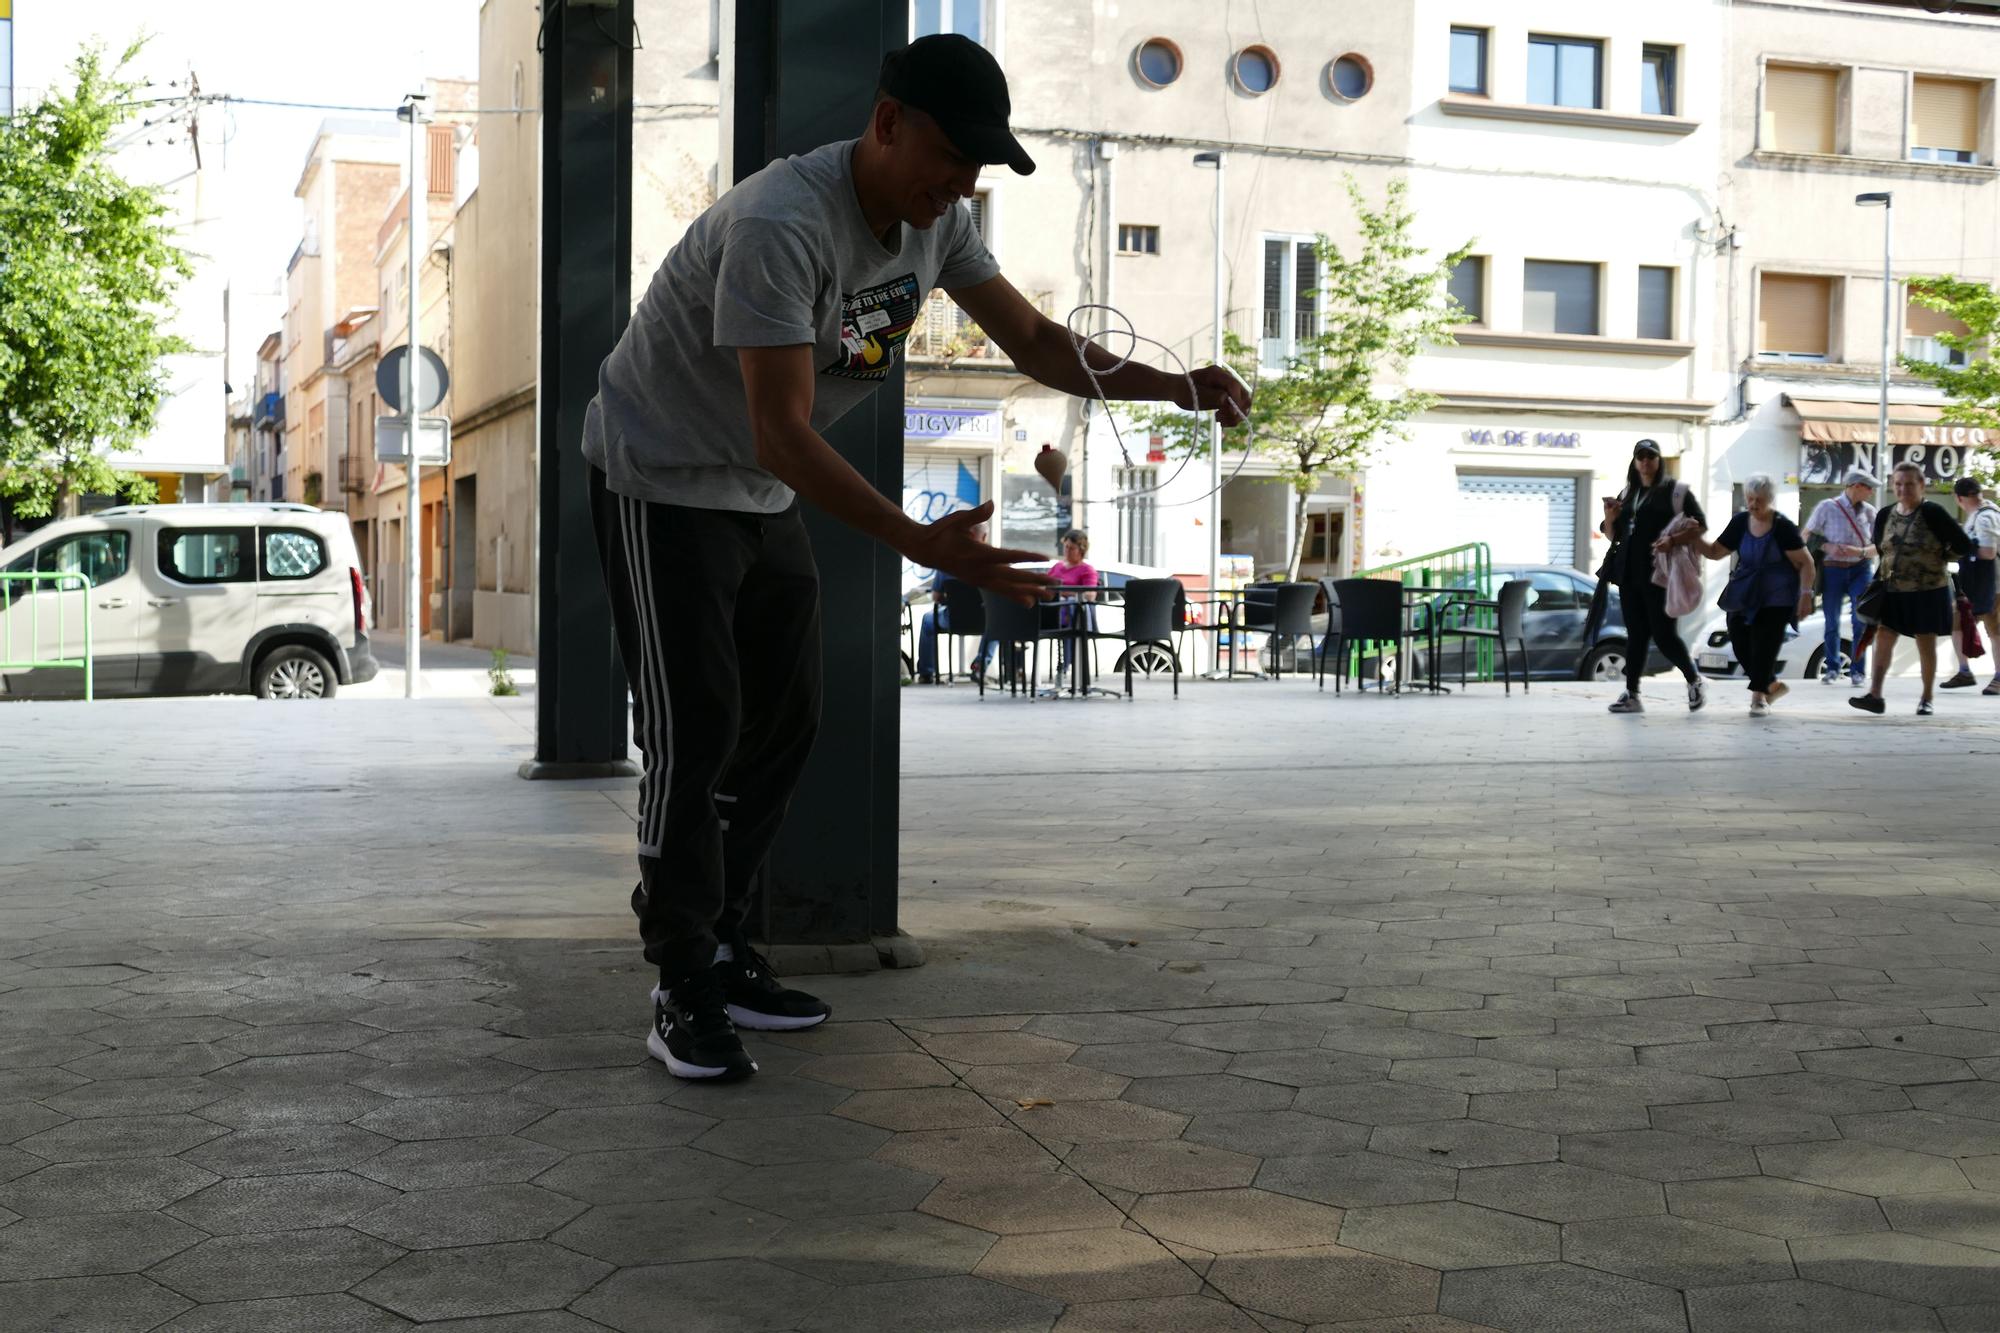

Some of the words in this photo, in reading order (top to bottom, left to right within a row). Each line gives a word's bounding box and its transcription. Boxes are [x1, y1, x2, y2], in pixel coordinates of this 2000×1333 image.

[873, 291, 891, 303] THE
[904, 414, 992, 432] UIGVERT
[1464, 428, 1496, 446] VA
[1501, 430, 1529, 447] DE
[1537, 432, 1582, 448] MAR
[1920, 426, 1984, 445] NICO
